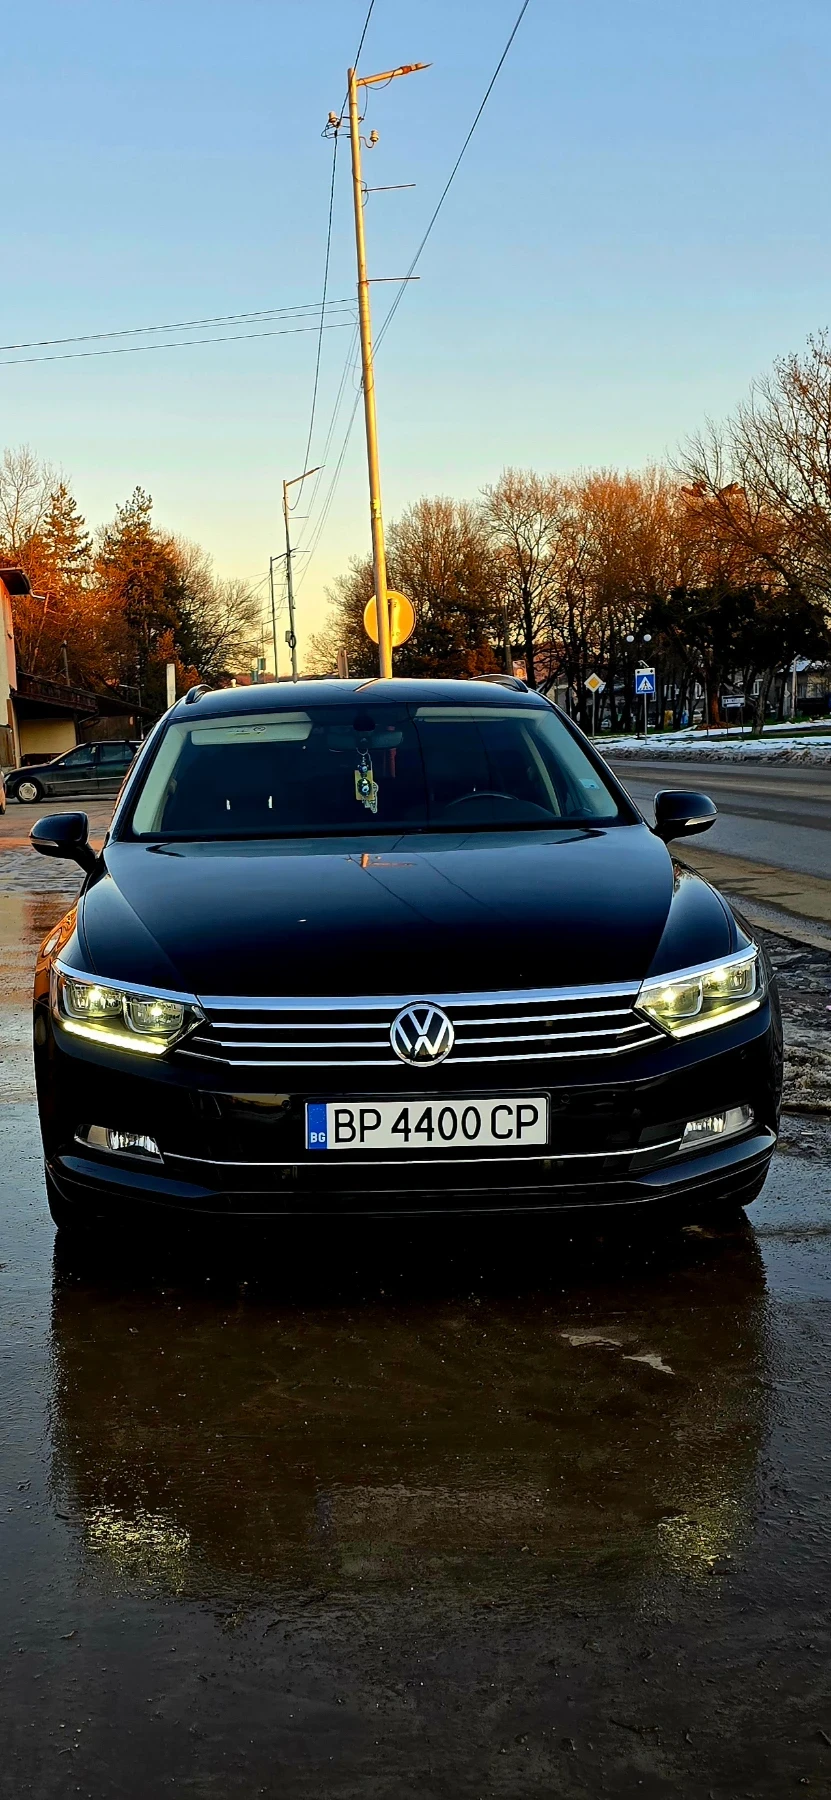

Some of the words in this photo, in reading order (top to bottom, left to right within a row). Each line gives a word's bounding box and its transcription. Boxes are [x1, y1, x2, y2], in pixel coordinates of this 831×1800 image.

[396, 1007, 449, 1062] VW
[310, 1132, 326, 1143] BG
[334, 1109, 382, 1144] BP
[391, 1106, 482, 1142] 4400
[490, 1104, 539, 1140] CP
